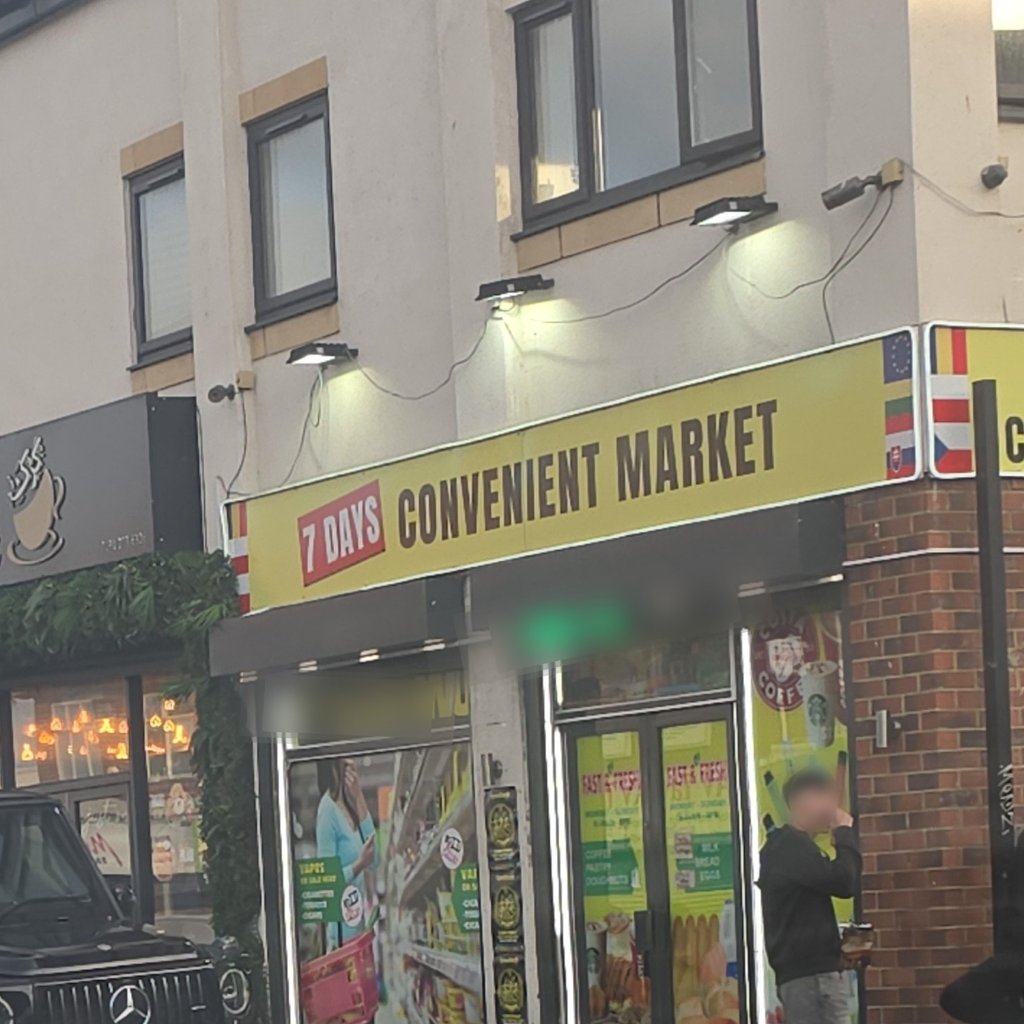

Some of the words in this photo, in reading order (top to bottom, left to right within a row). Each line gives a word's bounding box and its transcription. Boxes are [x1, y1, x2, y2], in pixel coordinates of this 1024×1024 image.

[398, 442, 600, 549] CONVENIENT
[616, 399, 777, 502] MARKET
[303, 523, 316, 573] 7
[323, 495, 381, 564] DAYS
